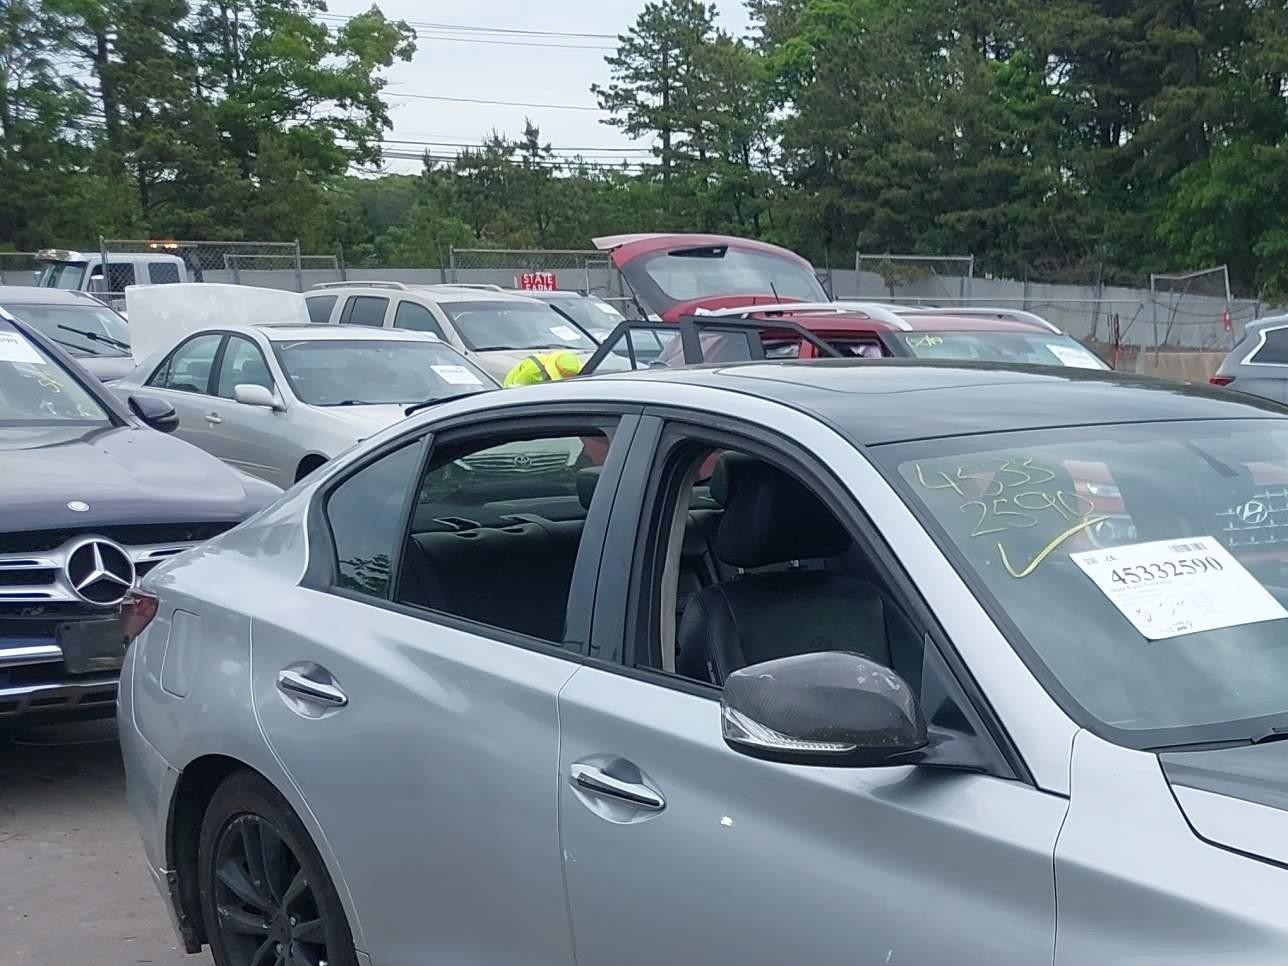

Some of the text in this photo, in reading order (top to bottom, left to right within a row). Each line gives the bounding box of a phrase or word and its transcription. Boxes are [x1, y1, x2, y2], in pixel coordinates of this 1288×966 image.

[523, 272, 553, 284] STATE
[915, 457, 1056, 496] 4533
[959, 489, 1095, 538] 2590
[1110, 555, 1224, 585] 45332590
